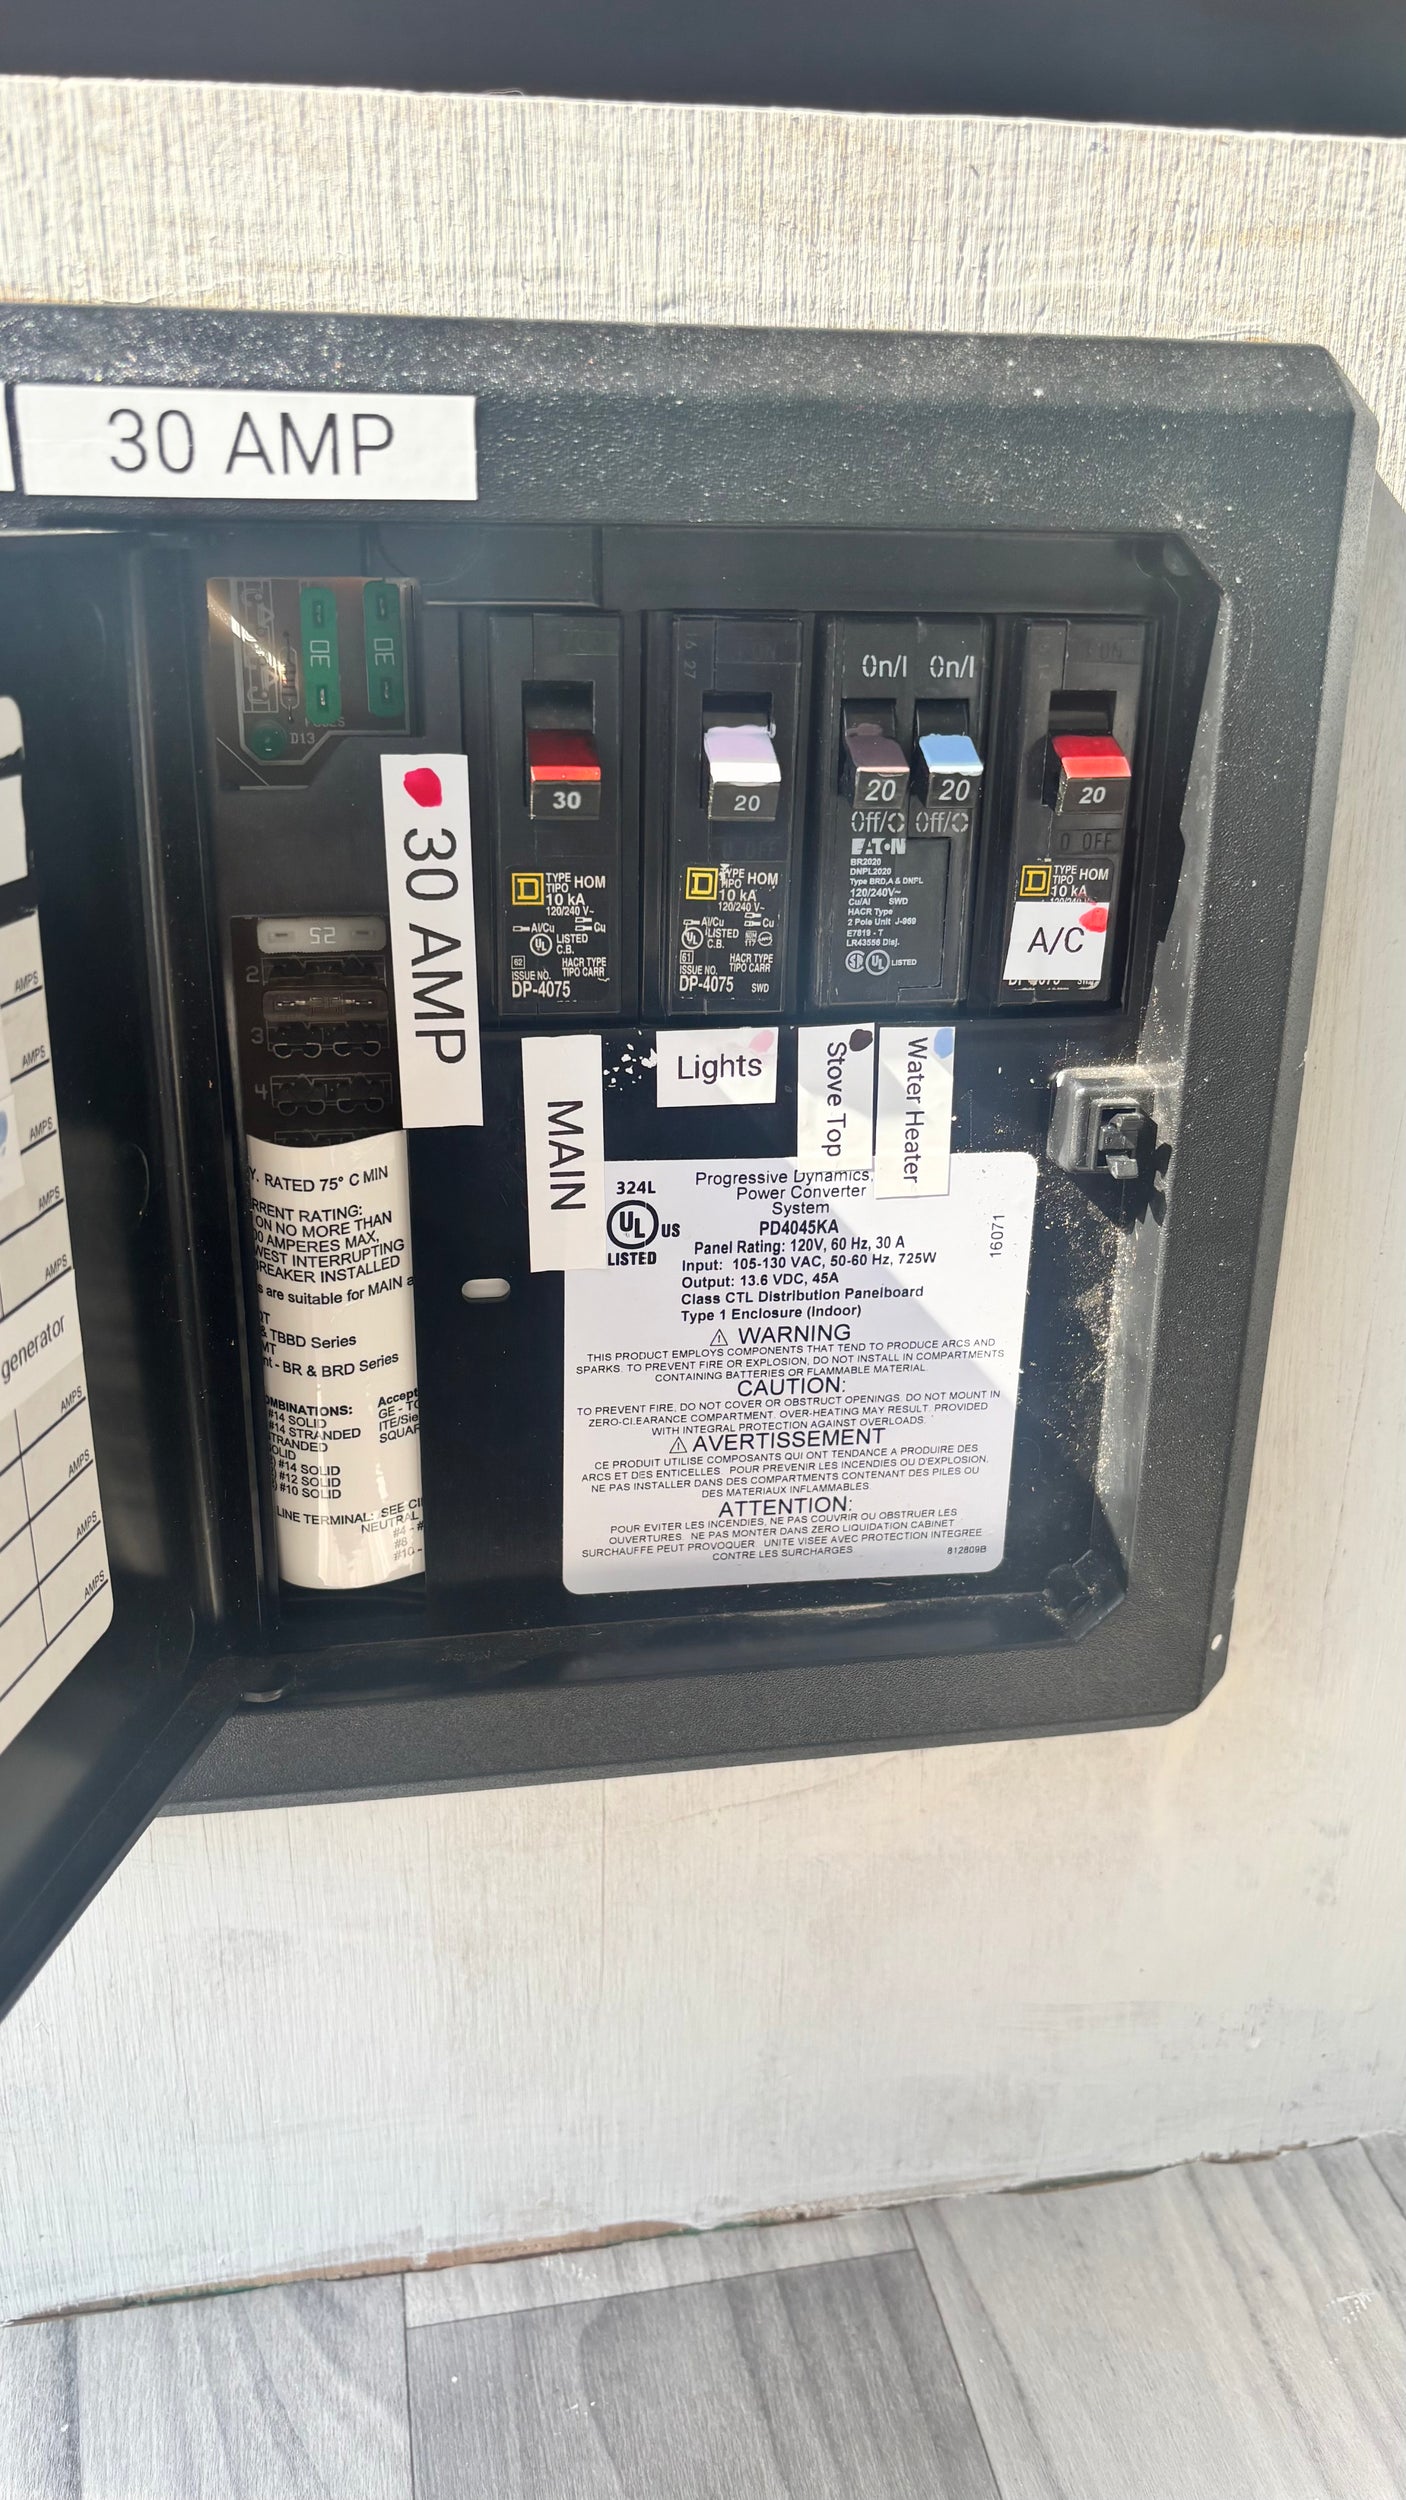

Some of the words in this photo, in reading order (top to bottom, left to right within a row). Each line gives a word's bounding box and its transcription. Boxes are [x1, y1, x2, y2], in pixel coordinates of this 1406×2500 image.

[108, 409, 194, 474] 30
[225, 411, 394, 475] AMP
[864, 779, 896, 801] 20
[938, 779, 970, 801] 20
[1078, 786, 1106, 805] 20
[552, 791, 582, 810] 30
[734, 795, 761, 812] 20
[851, 838, 906, 855] EATON
[403, 828, 458, 901] 30
[850, 867, 892, 875] DNPL2020
[851, 858, 881, 866] BR2020
[1054, 865, 1077, 875] TYPE
[546, 872, 571, 883] TYPE
[574, 876, 606, 889] HOM
[748, 872, 778, 885] HOM
[1053, 875, 1073, 885] TIPO
[1079, 868, 1109, 881] HOM
[546, 883, 569, 893] TIPO
[1051, 885, 1067, 897] 10
[1071, 885, 1087, 897] kA
[546, 893, 563, 906] 10
[568, 893, 586, 906] kA
[546, 906, 580, 916] 120/240
[874, 908, 893, 917] Type
[556, 934, 588, 944] LISTED
[708, 929, 739, 939] LISTED
[1027, 926, 1085, 955] A/C
[556, 944, 575, 954] C.B.
[562, 957, 584, 967] HACR
[587, 957, 607, 967] TYPE
[246, 966, 260, 983] 2
[512, 971, 535, 980] ISSUE
[562, 968, 580, 977] TIPO
[582, 967, 605, 977] CARR
[14, 972, 39, 992] AMPS
[512, 981, 571, 998] DP-4075
[679, 976, 734, 992] DP-4075
[751, 983, 770, 993] SWD
[409, 922, 467, 1065] AMP
[251, 1027, 265, 1044] 3
[22, 1045, 46, 1068] AMPS
[677, 1053, 762, 1084] Lights
[826, 1042, 847, 1106] Stove
[905, 1036, 928, 1104] Water
[254, 1084, 268, 1100] 4
[29, 1117, 54, 1141] AMPS
[822, 1113, 846, 1157] Top
[547, 1100, 586, 1210] MAIN
[903, 1110, 925, 1184] Heater
[264, 1173, 315, 1192] RATED
[349, 1173, 360, 1187] C
[363, 1166, 388, 1183] MIN
[616, 1181, 656, 1195] 324L
[695, 1171, 788, 1188] Progressive
[38, 1185, 61, 1211] AMPS
[737, 1186, 785, 1200] Power
[791, 1186, 866, 1200] Converter
[299, 1205, 363, 1222] RATING:
[772, 1202, 830, 1218] System
[276, 1221, 297, 1236] NO
[302, 1222, 350, 1238] MORE
[354, 1211, 392, 1231] THAN
[661, 1223, 681, 1238] US
[759, 1219, 839, 1236] PD4045KA
[266, 1235, 340, 1253] AMPERES
[694, 1241, 733, 1255] Panel
[737, 1240, 785, 1255] Rating:
[791, 1238, 827, 1252] 120V,
[831, 1237, 847, 1250] 60
[851, 1237, 871, 1251] Hz,
[876, 1236, 891, 1249] 30
[895, 1235, 905, 1248] A
[989, 1214, 1005, 1258] 16071
[292, 1239, 405, 1268] INTERRUPTING
[607, 1252, 657, 1266] LISTED
[682, 1260, 723, 1274] Input:
[733, 1257, 786, 1270] 105-130
[790, 1255, 825, 1269] VAC,
[830, 1254, 867, 1266] 50-60
[872, 1253, 893, 1266] Hz,
[899, 1252, 937, 1264] 725W
[44, 1253, 68, 1281] AMPS
[320, 1255, 400, 1283] INSTALLED
[266, 1288, 284, 1300] are
[288, 1292, 342, 1305] suitable
[347, 1288, 365, 1301] for
[368, 1276, 402, 1297] MAIN
[681, 1276, 735, 1290] Output:
[740, 1274, 768, 1286] 13.6
[773, 1273, 807, 1287] VDC,
[812, 1272, 839, 1284] 45A
[681, 1293, 721, 1305] Class
[725, 1292, 753, 1303] CTL
[758, 1289, 840, 1303] Distribution
[845, 1286, 924, 1299] Panelboard
[681, 1310, 715, 1324] Type
[731, 1306, 802, 1320] Enclosure
[807, 1304, 862, 1318] (Indoor)
[270, 1328, 306, 1348] TBBD
[311, 1336, 357, 1350] Series
[738, 1324, 851, 1345] WARNING
[1, 1314, 66, 1384] generator
[587, 1353, 612, 1362] THIS
[615, 1350, 669, 1361] PRODUCT
[672, 1348, 724, 1358] EMPLOYS
[727, 1345, 803, 1357] COMPONENTS
[807, 1344, 835, 1353] THAT
[838, 1343, 866, 1352] TEND
[870, 1342, 884, 1351] TO
[887, 1340, 938, 1350] PRODUCE
[941, 1339, 971, 1348] ARCS
[973, 1338, 995, 1347] AND
[282, 1361, 303, 1376] BR
[306, 1366, 317, 1377] &
[321, 1362, 355, 1378] BRD
[359, 1352, 400, 1372] Series
[737, 1376, 846, 1397] CAUTION:
[60, 1385, 83, 1412] AMPS
[692, 1427, 886, 1452] AVERTISSEMENT
[67, 1448, 90, 1477] AMPS
[278, 1459, 297, 1473] #14
[300, 1464, 341, 1476] SOLID
[279, 1471, 298, 1484] #12
[301, 1476, 341, 1487] SOLID
[280, 1483, 298, 1496] #10
[302, 1488, 341, 1499] SOLID
[718, 1496, 852, 1518] ATTENTION:
[75, 1510, 98, 1539] AMPS
[83, 1568, 106, 1600] AMPS
